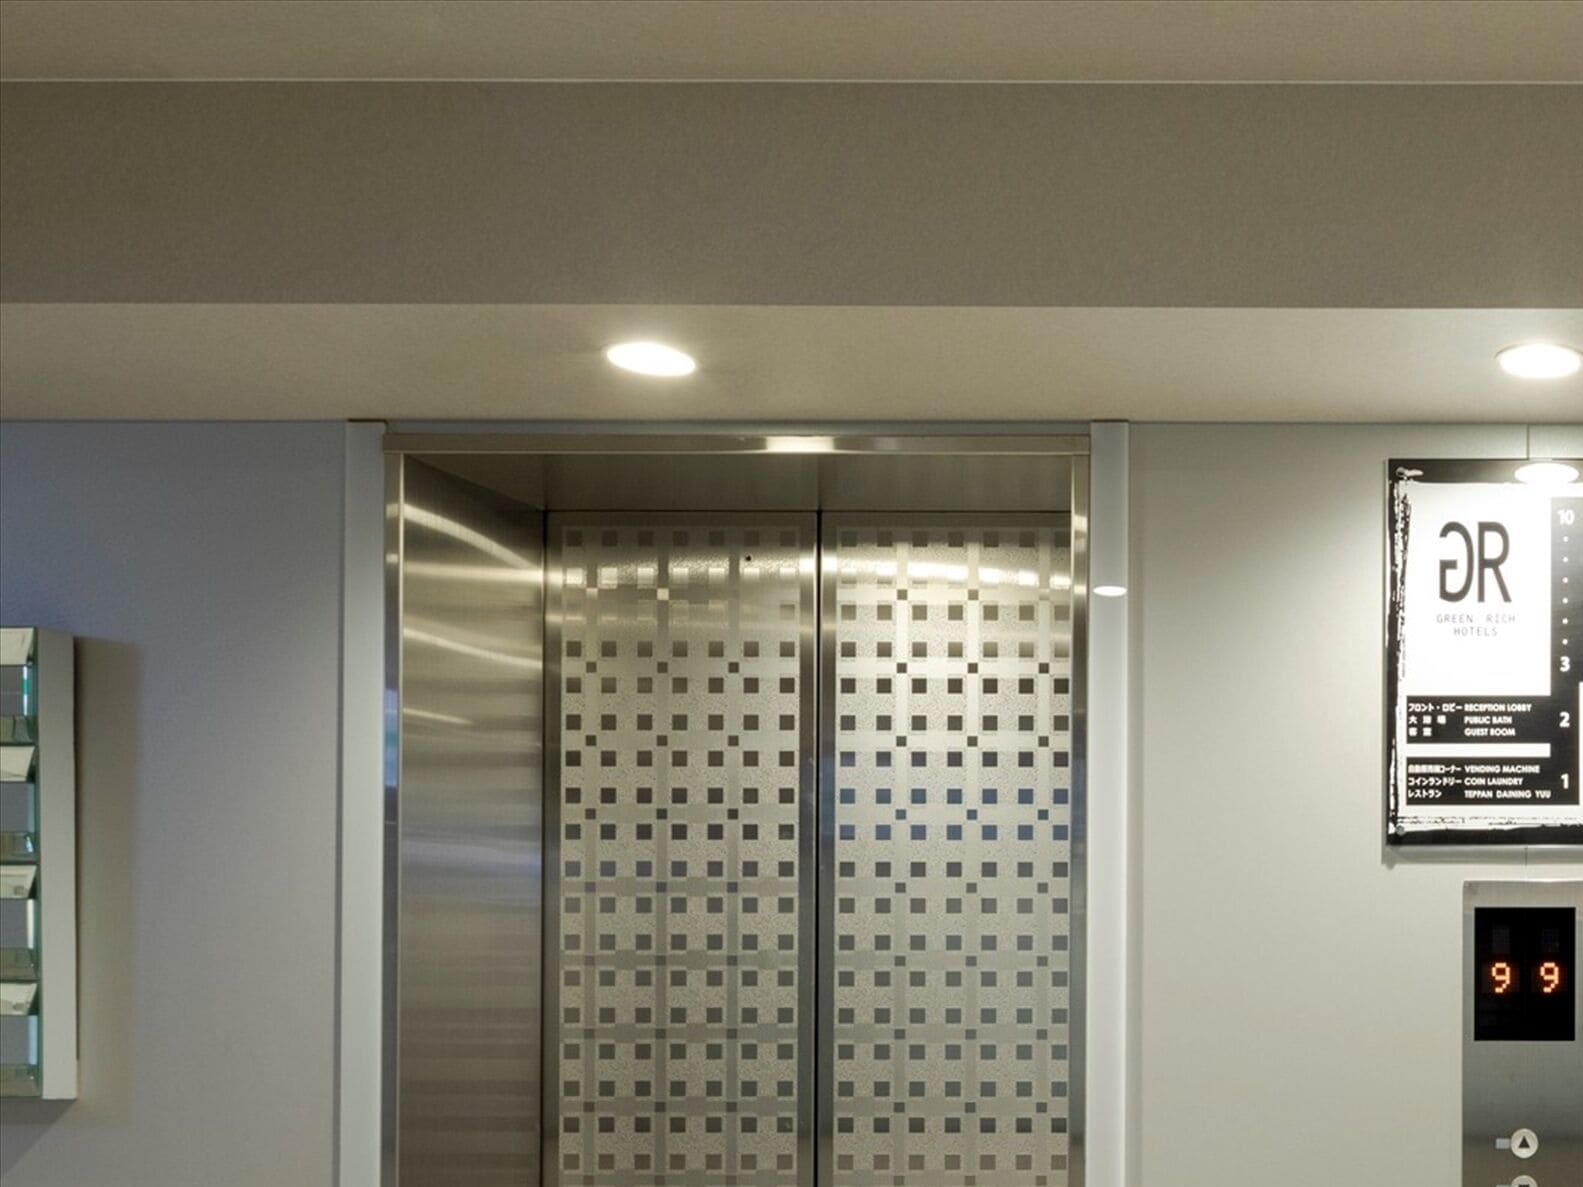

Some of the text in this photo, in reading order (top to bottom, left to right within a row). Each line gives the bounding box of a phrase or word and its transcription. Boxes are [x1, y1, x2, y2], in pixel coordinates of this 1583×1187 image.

[1557, 509, 1575, 525] 10
[1436, 613, 1516, 624] GREEN RICH
[1453, 626, 1498, 636] HOTELS
[1560, 656, 1571, 672] 3
[1464, 703, 1532, 712] RECEPTION LOBBY
[1559, 711, 1570, 728] 2
[1464, 728, 1515, 736] GUEST ROOM
[1502, 765, 1540, 773] MACHINE
[1464, 777, 1523, 786] COIN LAUNDRY
[1560, 773, 1569, 789] 1
[1408, 789, 1442, 798] レストラン
[1464, 790, 1493, 798] TEPPAN
[1492, 962, 1559, 993] 9 9
